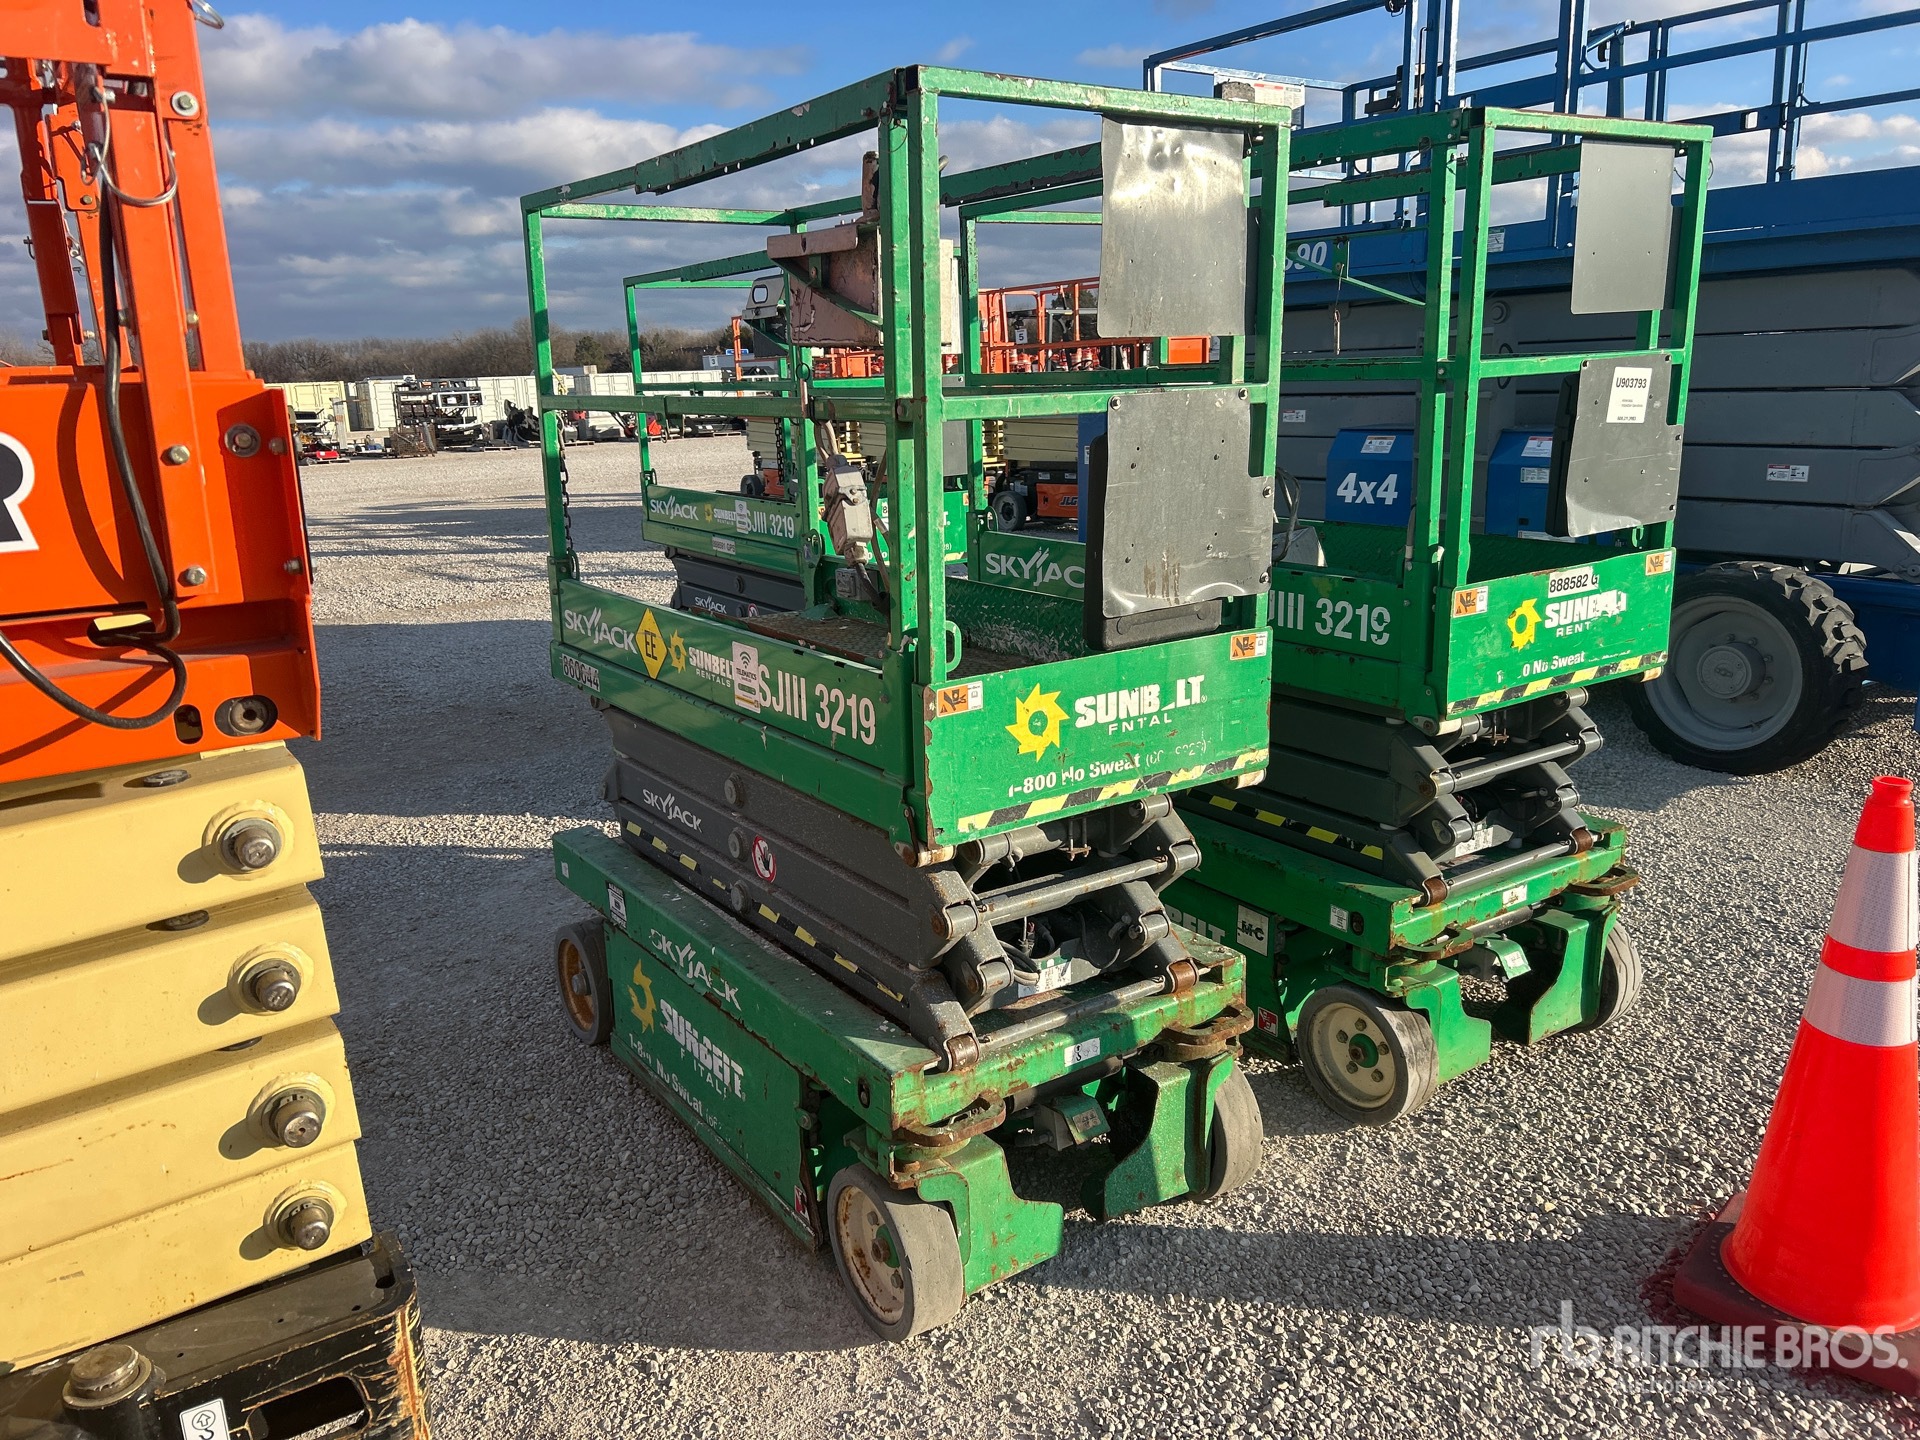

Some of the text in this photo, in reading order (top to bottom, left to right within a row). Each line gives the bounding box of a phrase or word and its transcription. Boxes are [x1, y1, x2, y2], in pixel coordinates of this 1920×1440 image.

[1616, 377, 1648, 388] U903793
[1336, 472, 1398, 505] 4x4
[650, 495, 699, 521] SKYJACK
[769, 513, 795, 538] 3219
[985, 546, 1086, 588] SKYJAC
[1550, 574, 1589, 593] 888582
[695, 596, 727, 614] SKYJACK
[564, 607, 638, 655] SKYJACK
[1315, 597, 1391, 646] 3219
[644, 629, 658, 661] EE
[1551, 651, 1585, 670] Sweat
[695, 668, 731, 689] RENTALS
[759, 664, 808, 722] SJIII
[814, 683, 876, 745] 3219
[1075, 675, 1204, 728] SUNBLT
[1089, 753, 1141, 778] Sweat
[642, 789, 702, 833] SKYJACK
